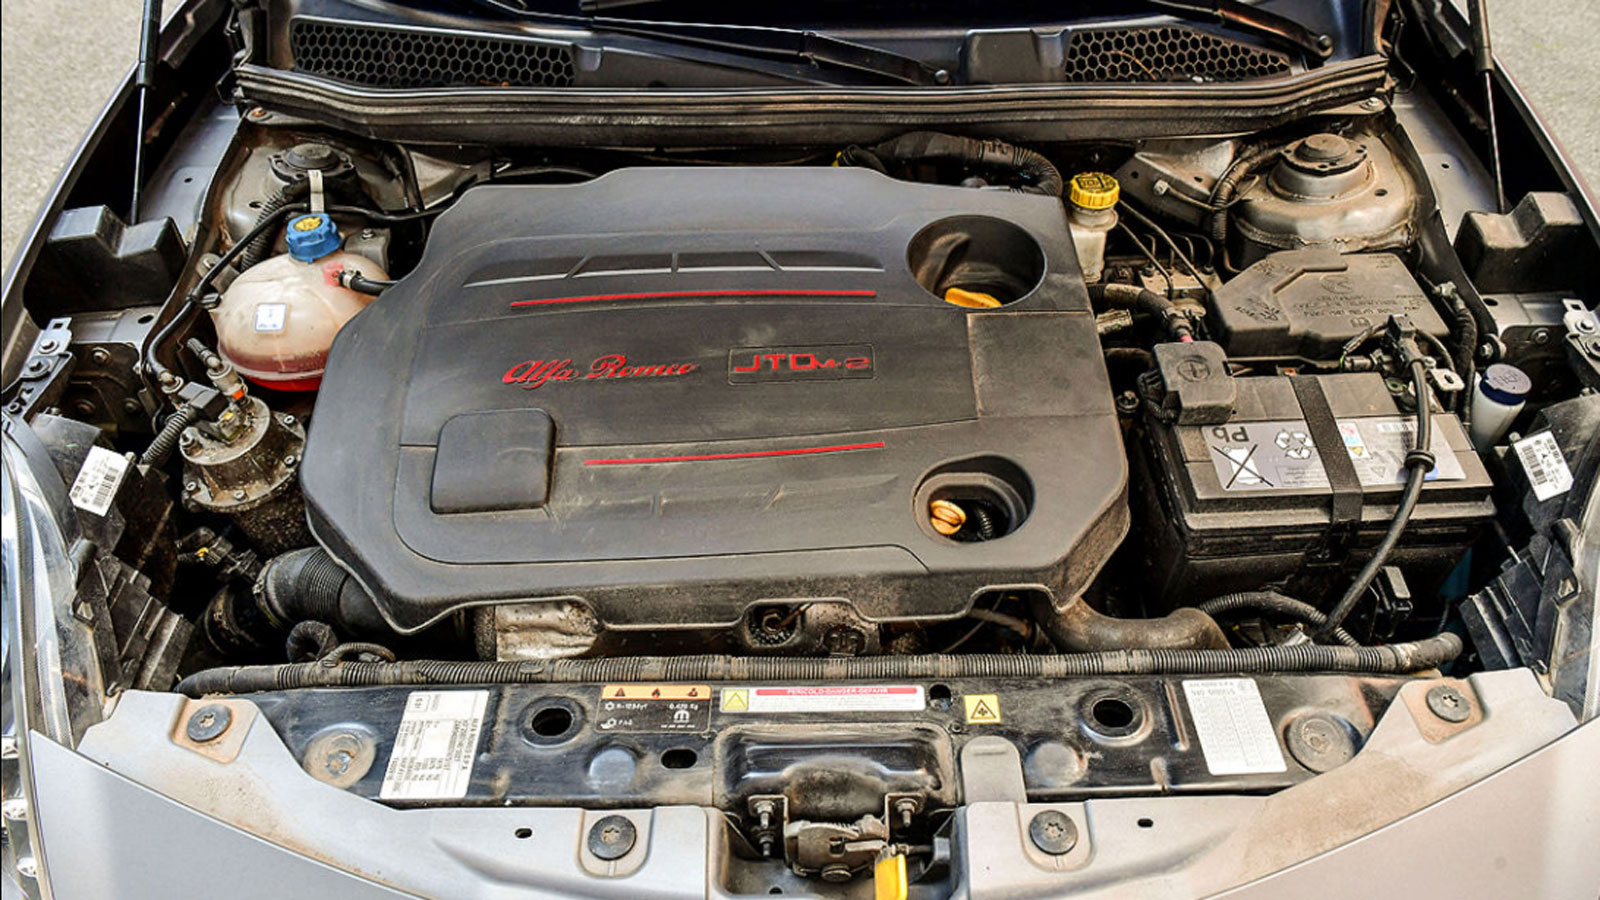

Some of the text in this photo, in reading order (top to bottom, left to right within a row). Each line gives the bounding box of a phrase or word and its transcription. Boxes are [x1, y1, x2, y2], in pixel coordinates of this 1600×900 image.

[502, 354, 697, 389] Alfa Romeo
[1212, 426, 1249, 443] Pb
